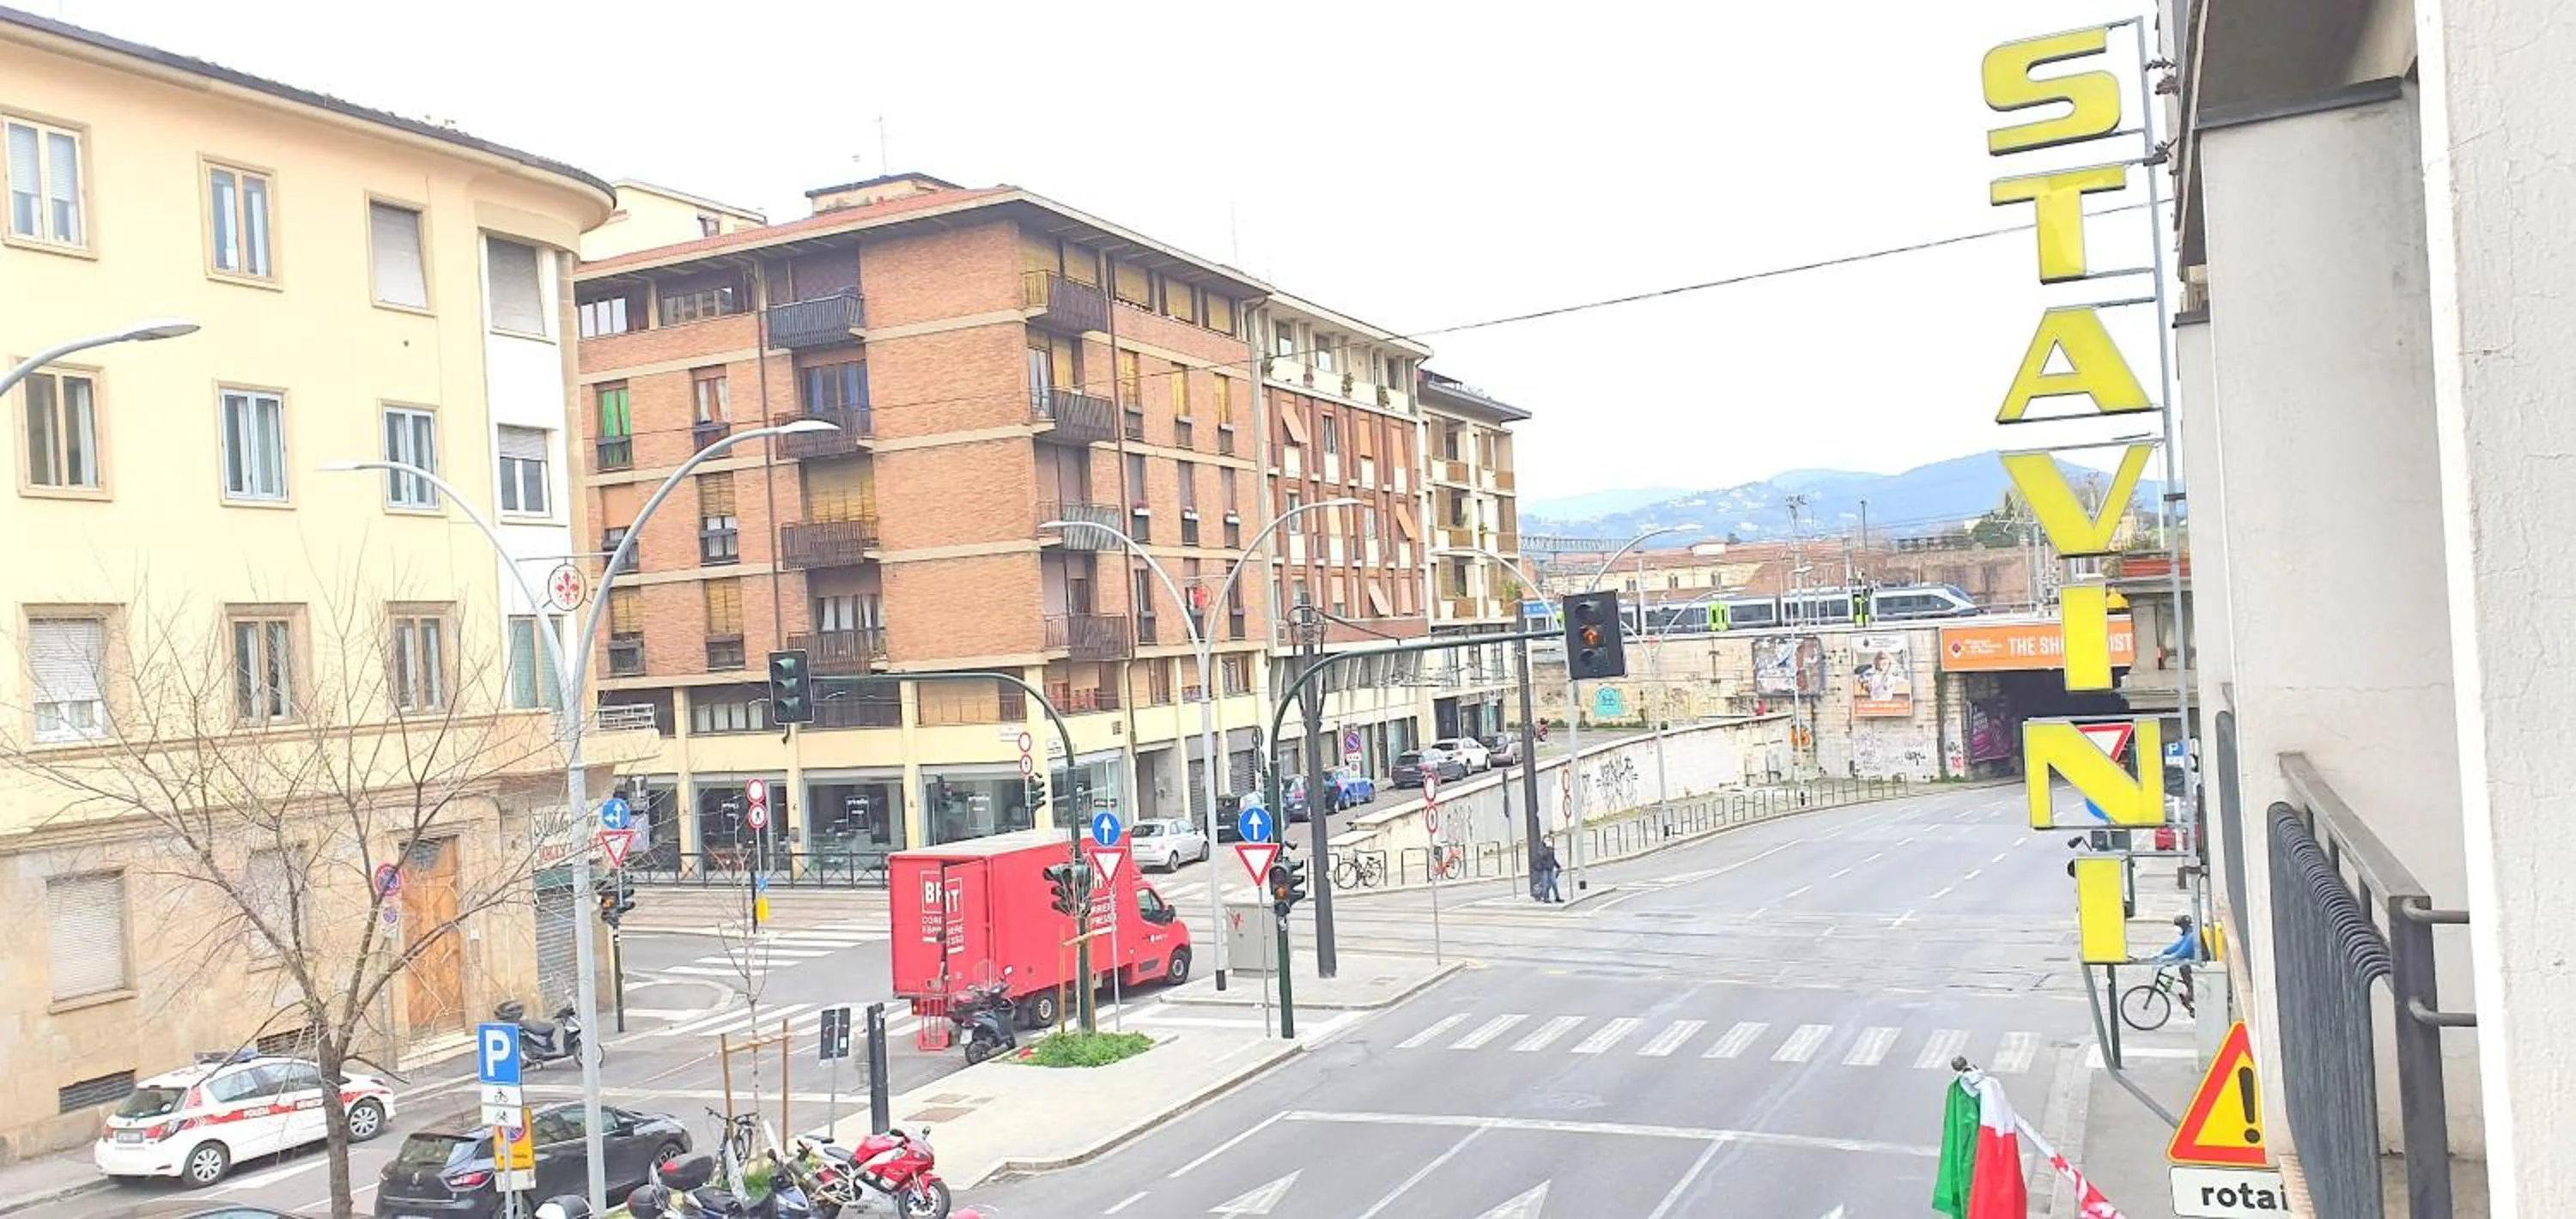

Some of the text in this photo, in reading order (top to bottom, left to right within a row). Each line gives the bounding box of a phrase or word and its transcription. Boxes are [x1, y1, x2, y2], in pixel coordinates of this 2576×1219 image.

[1982, 27, 2166, 963] STAVINI
[2007, 637, 2036, 657] THE
[2168, 743, 2179, 755] P
[485, 1029, 511, 1076] P
